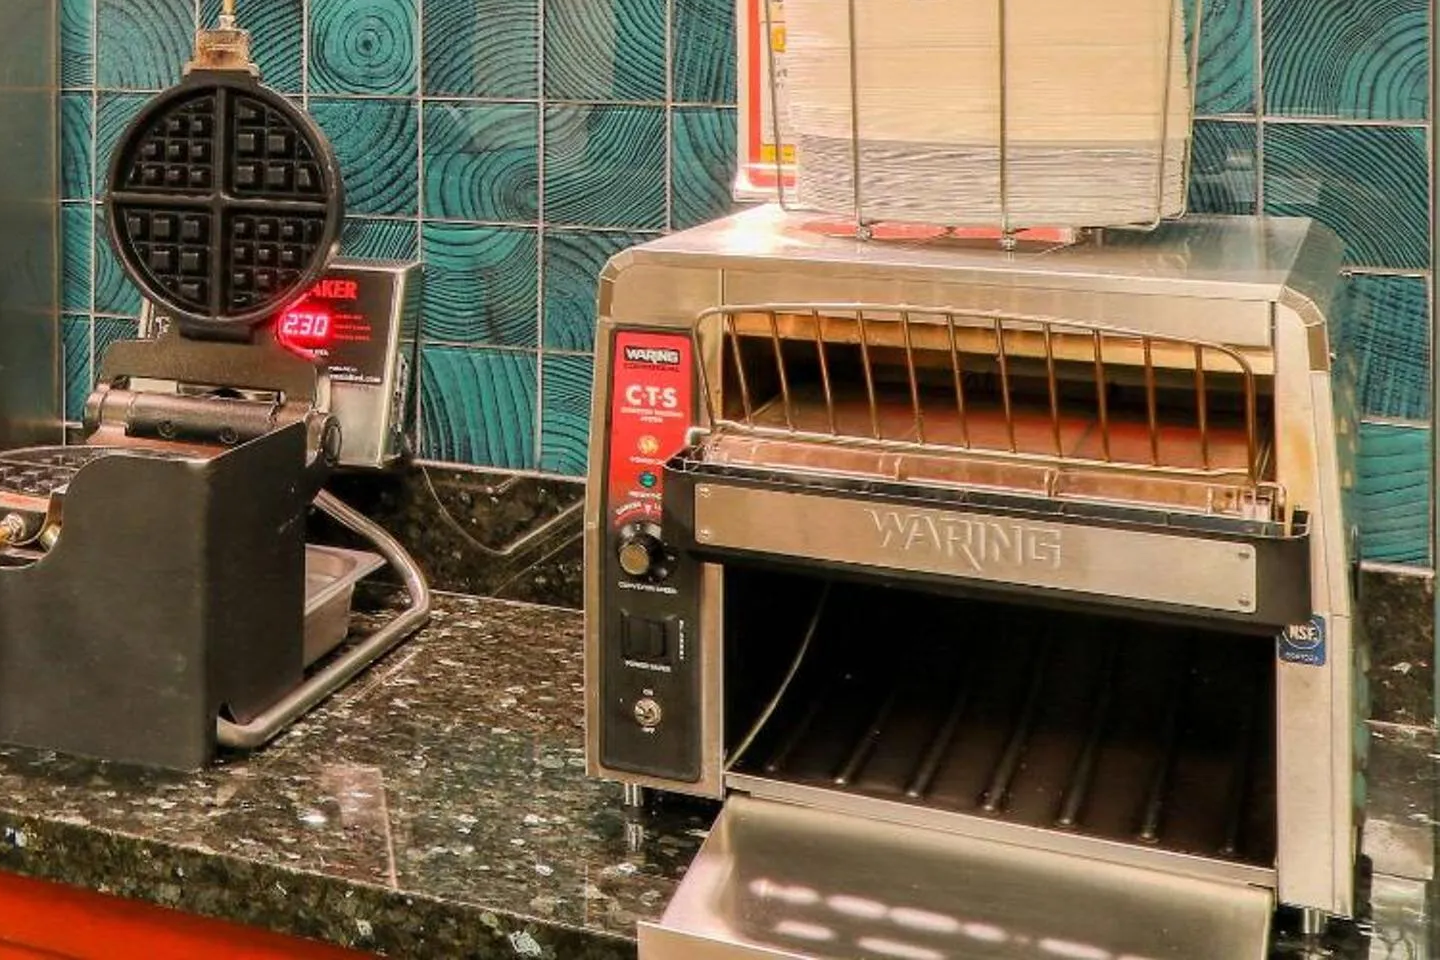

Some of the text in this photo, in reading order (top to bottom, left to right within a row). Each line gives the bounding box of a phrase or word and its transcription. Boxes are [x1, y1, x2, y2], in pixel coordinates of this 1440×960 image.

[310, 280, 358, 300] AKER
[624, 347, 680, 365] WARING
[864, 508, 1061, 572] WARING
